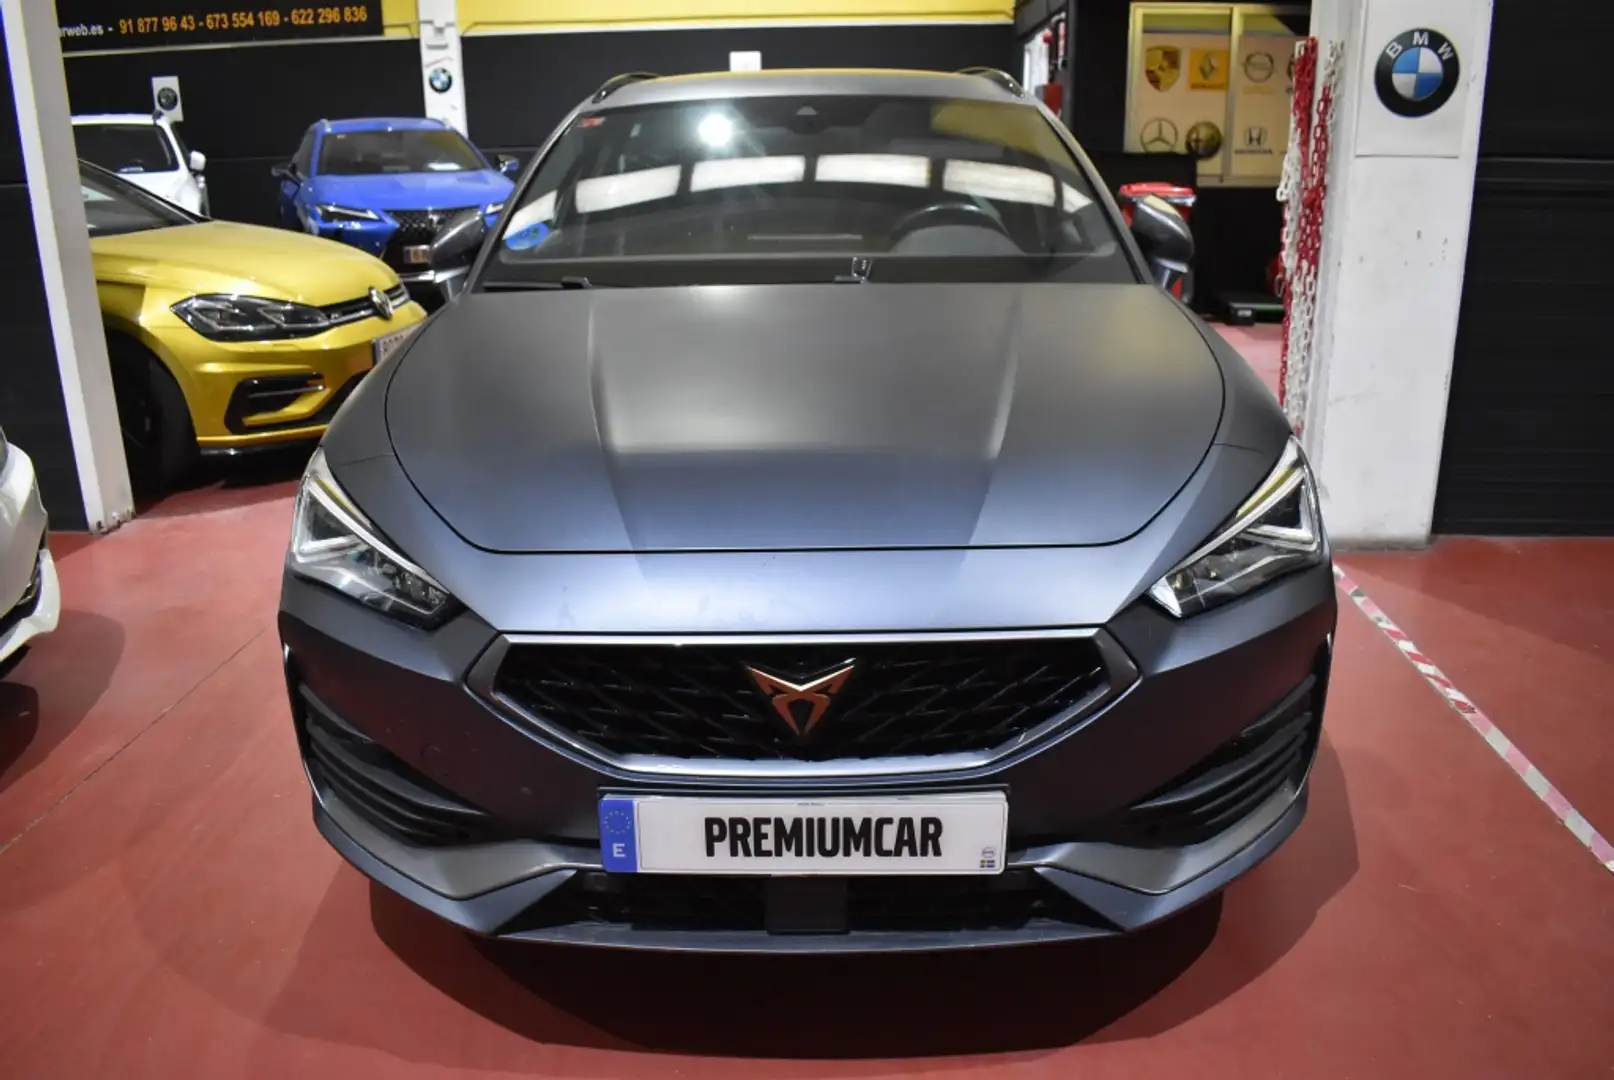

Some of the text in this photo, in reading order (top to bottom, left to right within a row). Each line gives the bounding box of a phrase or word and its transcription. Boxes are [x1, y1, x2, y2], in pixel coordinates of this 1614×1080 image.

[118, 19, 133, 34] 91
[137, 17, 158, 33] 877
[162, 15, 178, 32] 96
[180, 15, 196, 31] 43
[206, 13, 229, 30] 673
[231, 12, 255, 28] 554
[258, 10, 281, 27] 169
[292, 8, 315, 24] 622
[317, 7, 341, 24] 296
[345, 6, 367, 22] 836
[1386, 31, 1454, 60] BMW
[612, 816, 943, 858] E PREMIUMCAR
